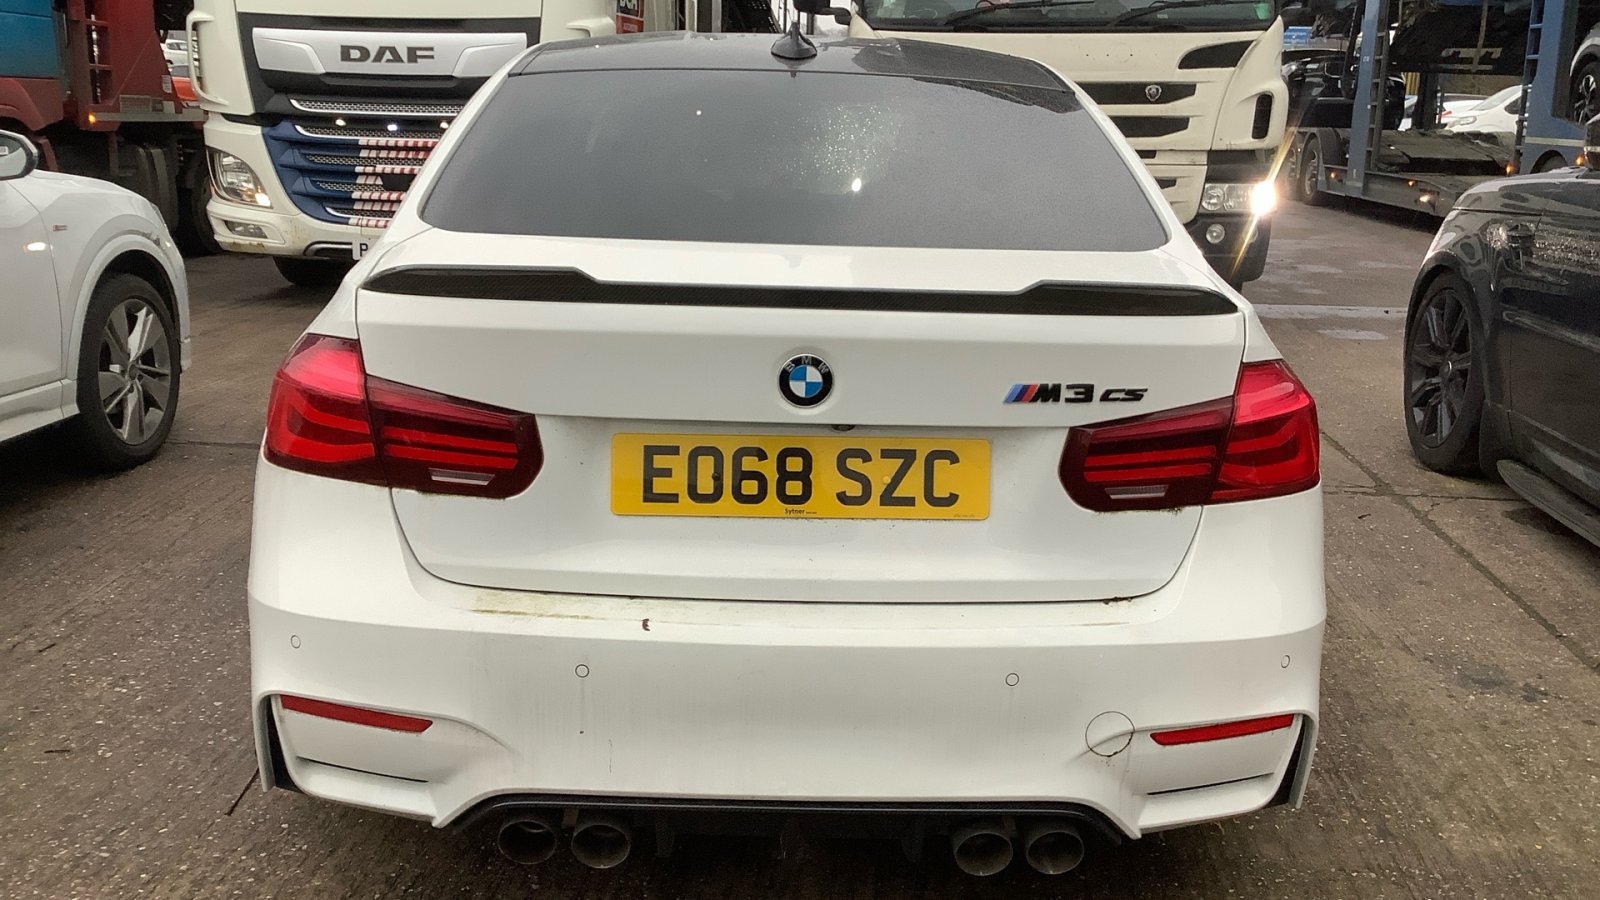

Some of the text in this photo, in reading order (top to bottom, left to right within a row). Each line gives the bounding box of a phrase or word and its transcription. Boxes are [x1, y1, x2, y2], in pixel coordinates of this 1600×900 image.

[340, 45, 435, 63] DAF
[783, 355, 830, 375] BMW
[1099, 388, 1149, 402] CS
[641, 445, 960, 507] EO68 SZC
